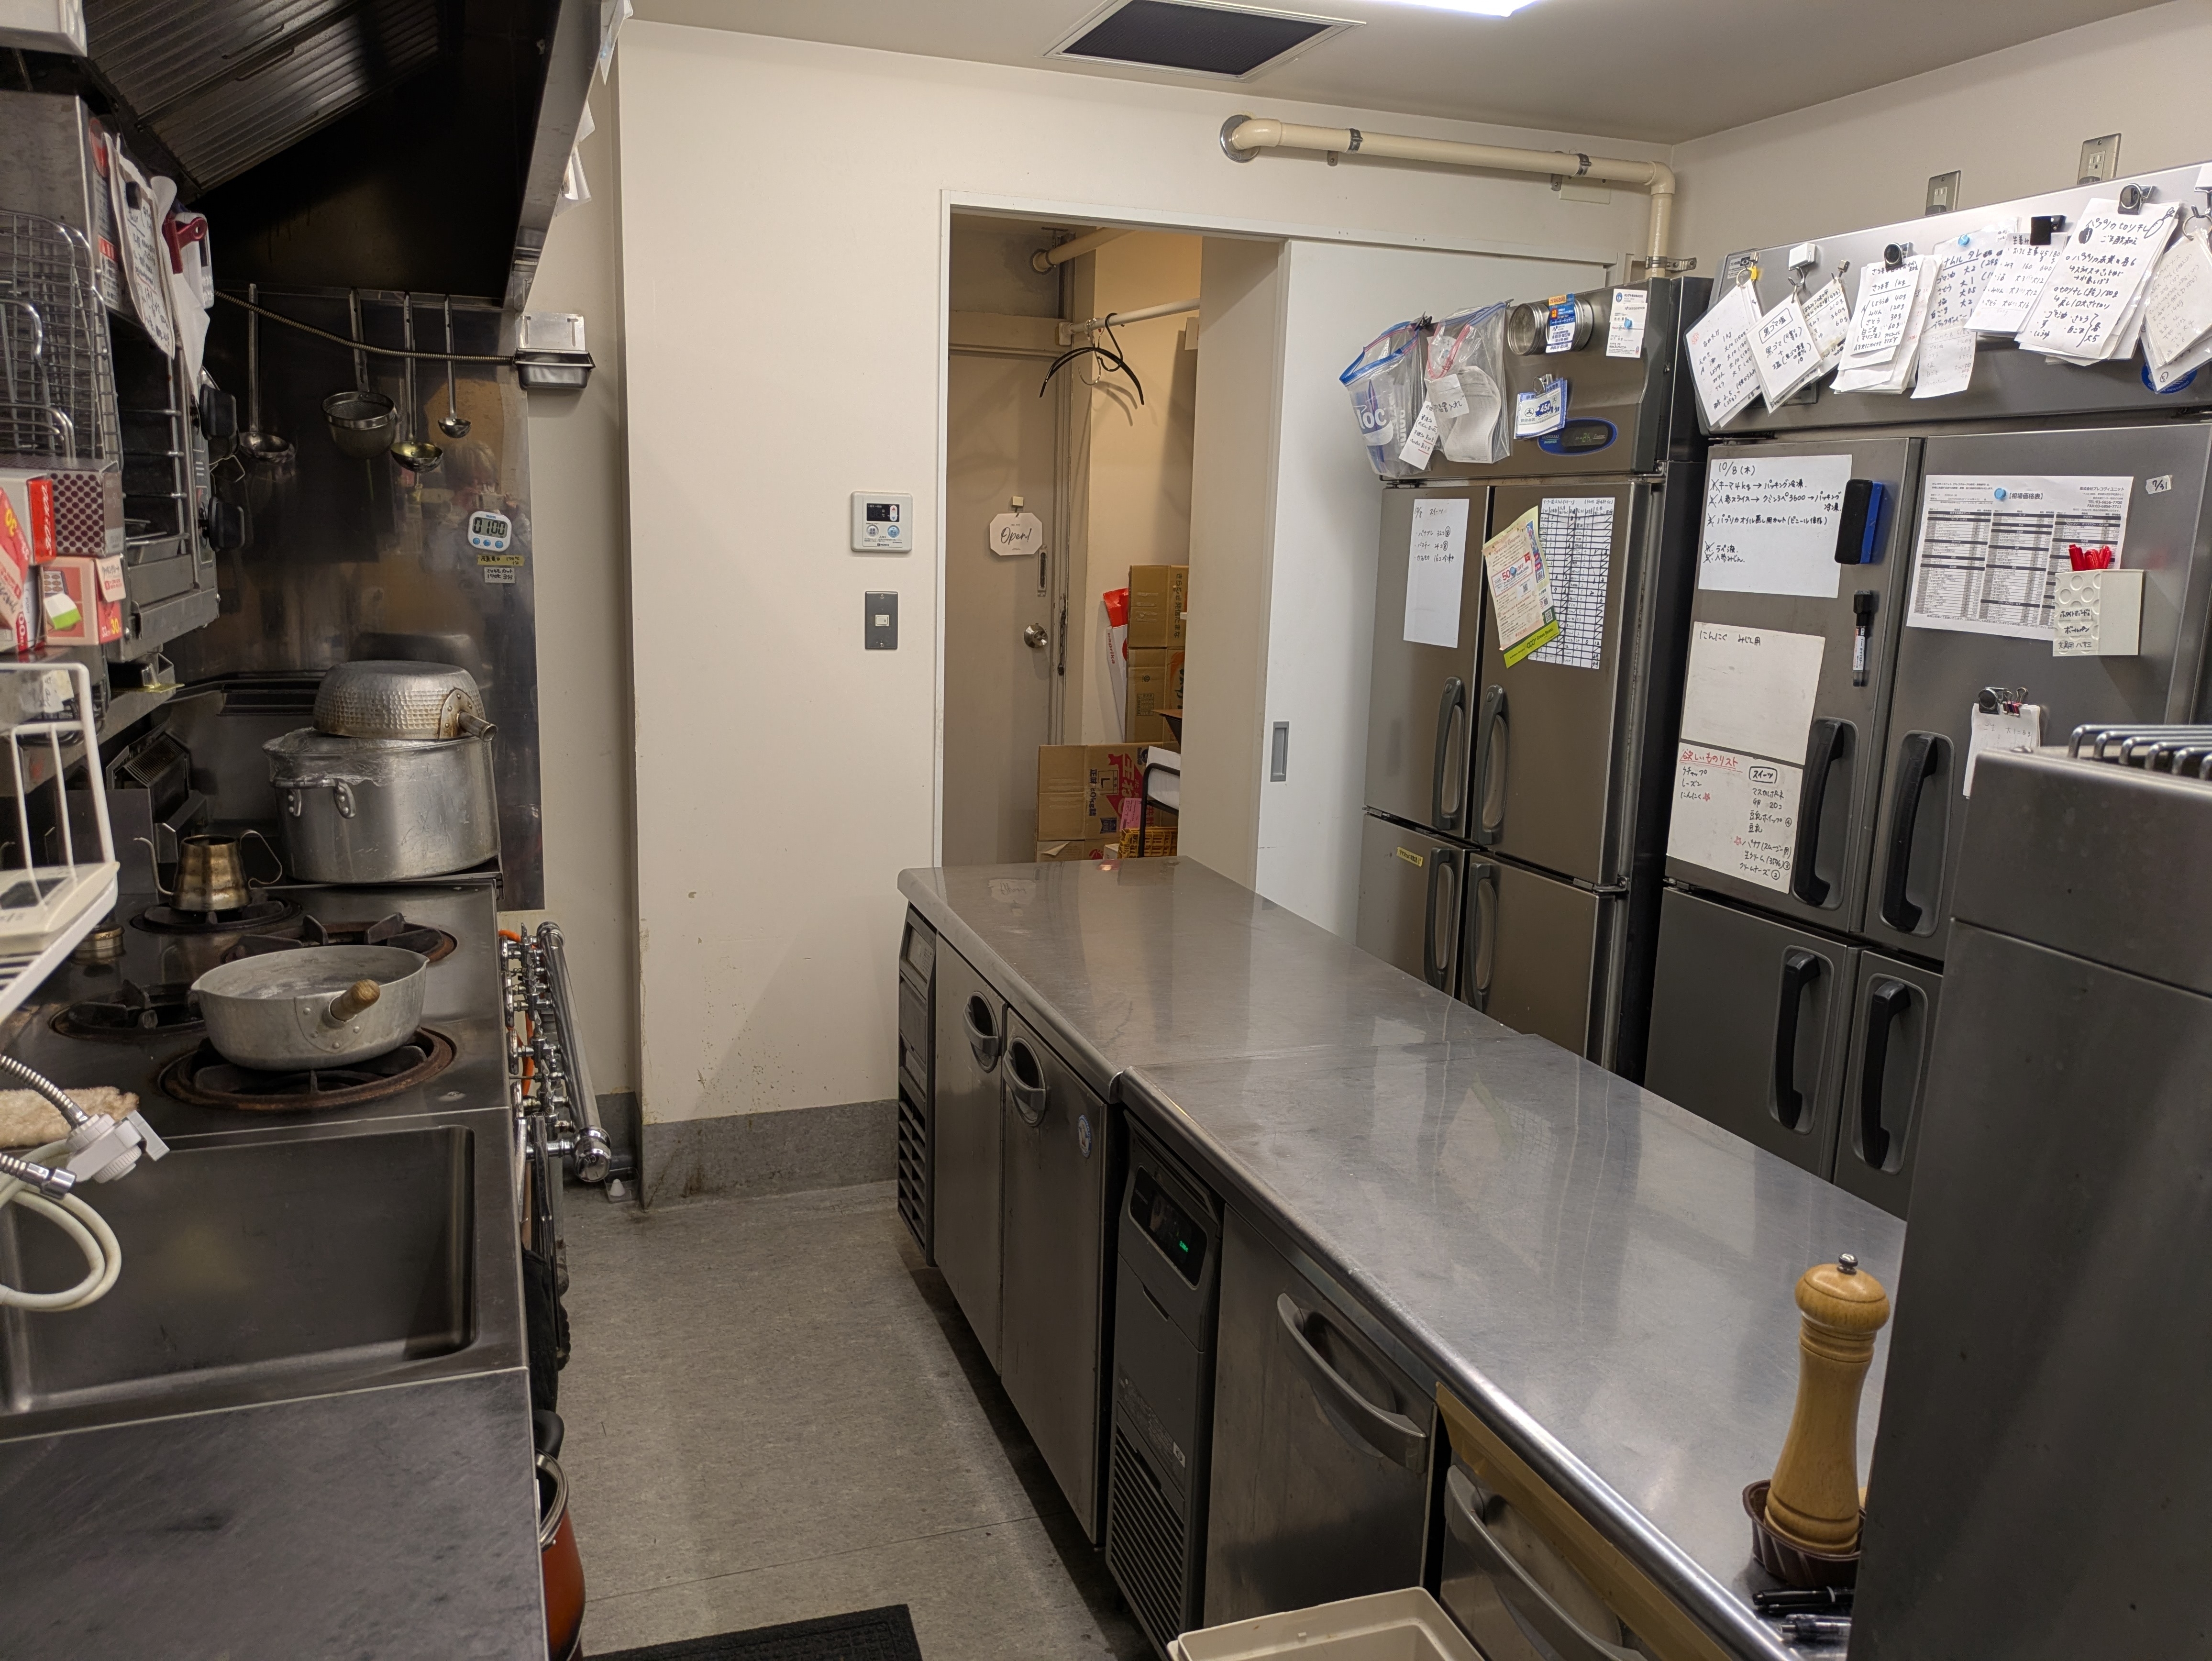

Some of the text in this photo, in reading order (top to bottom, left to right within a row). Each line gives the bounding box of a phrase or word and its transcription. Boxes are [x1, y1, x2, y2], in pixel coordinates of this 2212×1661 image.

[1964, 266, 1976, 275] 大2
[1895, 279, 1906, 287] 1kg
[1829, 299, 1844, 310] 210g
[1960, 299, 1973, 308] 大2
[1831, 308, 1846, 320] 360g
[1836, 317, 1848, 326] 60g
[1764, 316, 1787, 339] 黒ゴマ塩
[1766, 341, 1782, 358] 黒ゴマ
[1701, 366, 1704, 375] A
[1719, 462, 1755, 476] 10/8 (木)
[2153, 479, 2168, 491] 7/31
[1001, 527, 1032, 545] Open!
[110, 618, 120, 634] 30
[1700, 630, 1727, 641] にんにく
[1107, 632, 1115, 664] paprika
[1680, 750, 1738, 766] 欲しいものリスト
[1682, 766, 1708, 776] ケチャップ
[1753, 770, 1773, 779] スイーツ
[1101, 777, 1110, 789] L
[1682, 778, 1702, 787] レーズン
[1681, 791, 1702, 800] にんにく
[1753, 788, 1784, 799] マスカルポーネ
[1753, 798, 1761, 808] 卵
[1749, 810, 1782, 823] 豆乳ホイップ
[1748, 823, 1763, 832] 豆乳
